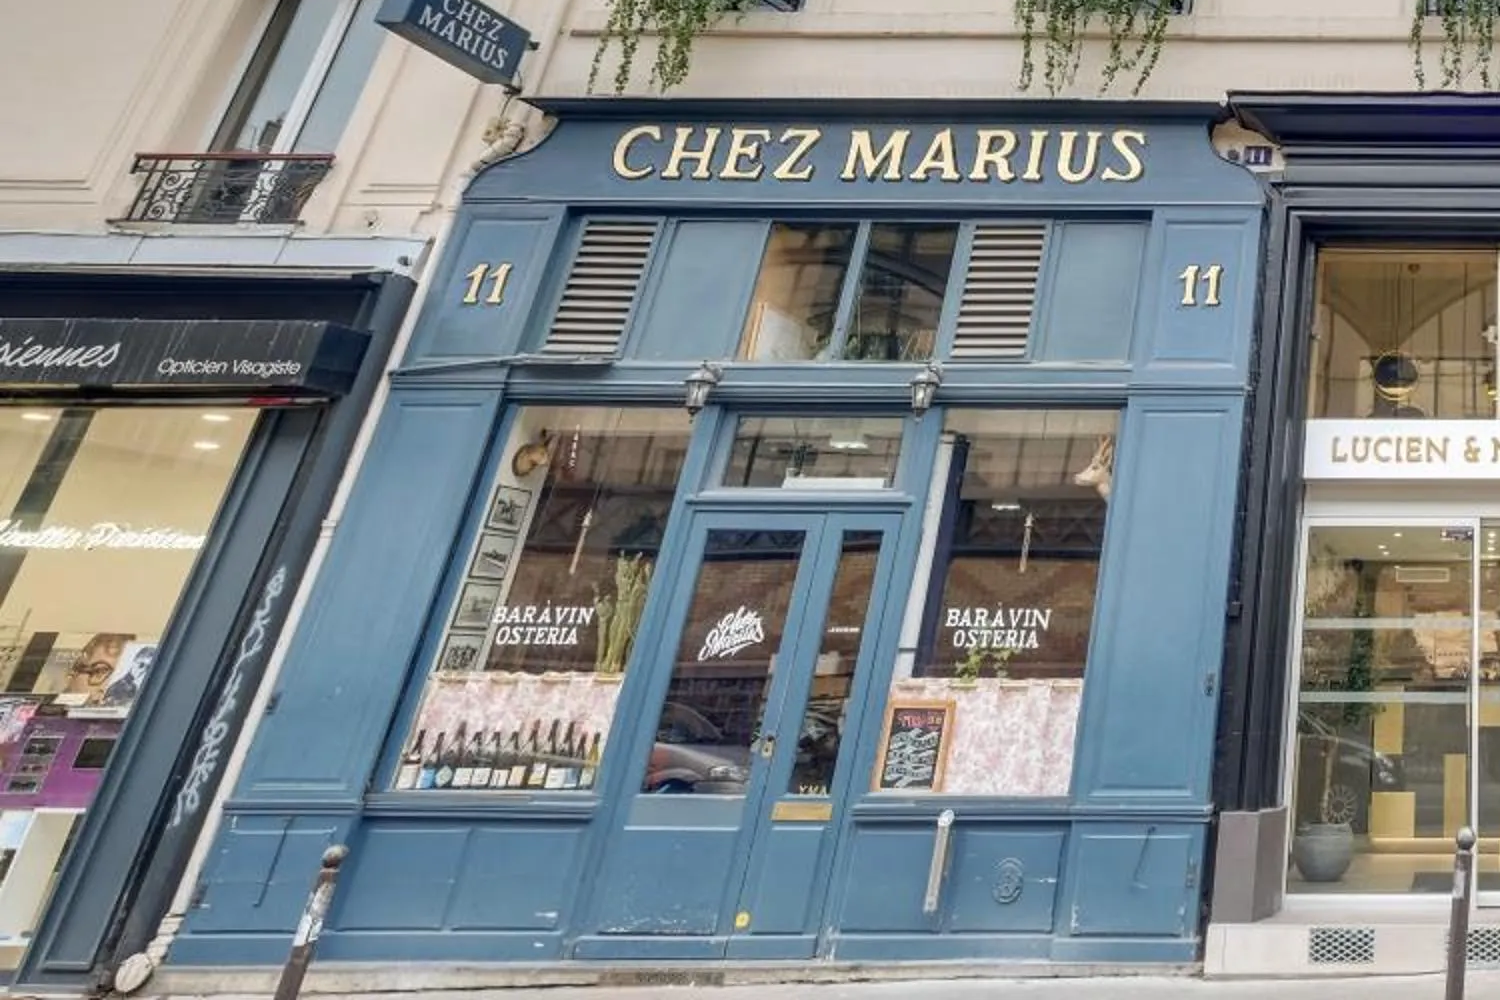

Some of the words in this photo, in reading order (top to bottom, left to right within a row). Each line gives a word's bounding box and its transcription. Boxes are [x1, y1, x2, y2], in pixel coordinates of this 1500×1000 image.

[418, 4, 509, 69] MARIUS
[612, 125, 822, 181] CHEZ
[840, 127, 1147, 182] MARIUS
[463, 262, 513, 305] 11
[1178, 264, 1224, 306] 11
[157, 358, 228, 375] Opticien
[232, 358, 301, 375] Visagiste
[1331, 437, 1450, 464] LUCIEN
[1463, 438, 1482, 463] &
[495, 625, 578, 646] OSTERIA
[953, 628, 1040, 649] OSTERIA
